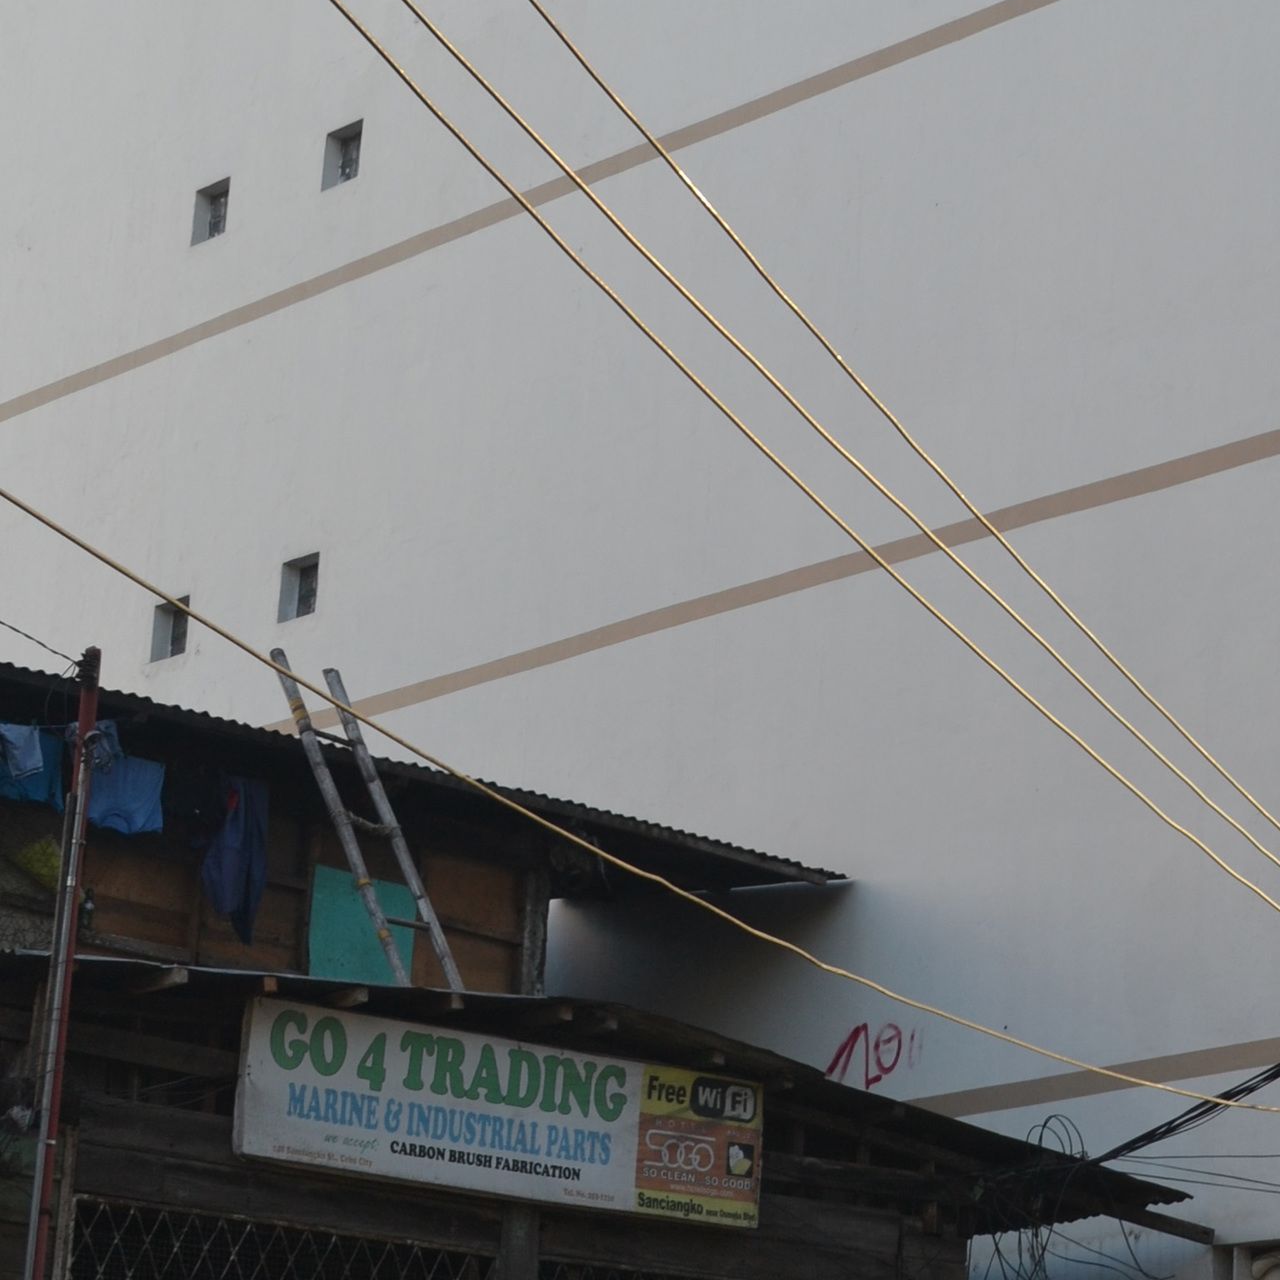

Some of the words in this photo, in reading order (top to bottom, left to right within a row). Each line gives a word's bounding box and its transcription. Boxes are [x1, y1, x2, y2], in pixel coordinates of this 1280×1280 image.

[270, 1009, 347, 1077] GO
[357, 1031, 387, 1092] 4
[400, 1029, 627, 1122] TRADING
[647, 1075, 686, 1105] Free
[286, 1081, 380, 1130] MARINE
[384, 1097, 403, 1134] &
[407, 1101, 542, 1157] INDUSTRIAL
[547, 1125, 612, 1166] PARTS
[390, 1140, 446, 1162] CARBON
[448, 1149, 492, 1169] BRUSH
[495, 1155, 582, 1182] FABRICATION
[643, 1129, 716, 1172] SOGO
[643, 1167, 657, 1178] SO
[705, 1176, 719, 1186] SO
[637, 1191, 704, 1217] Sanciangko
